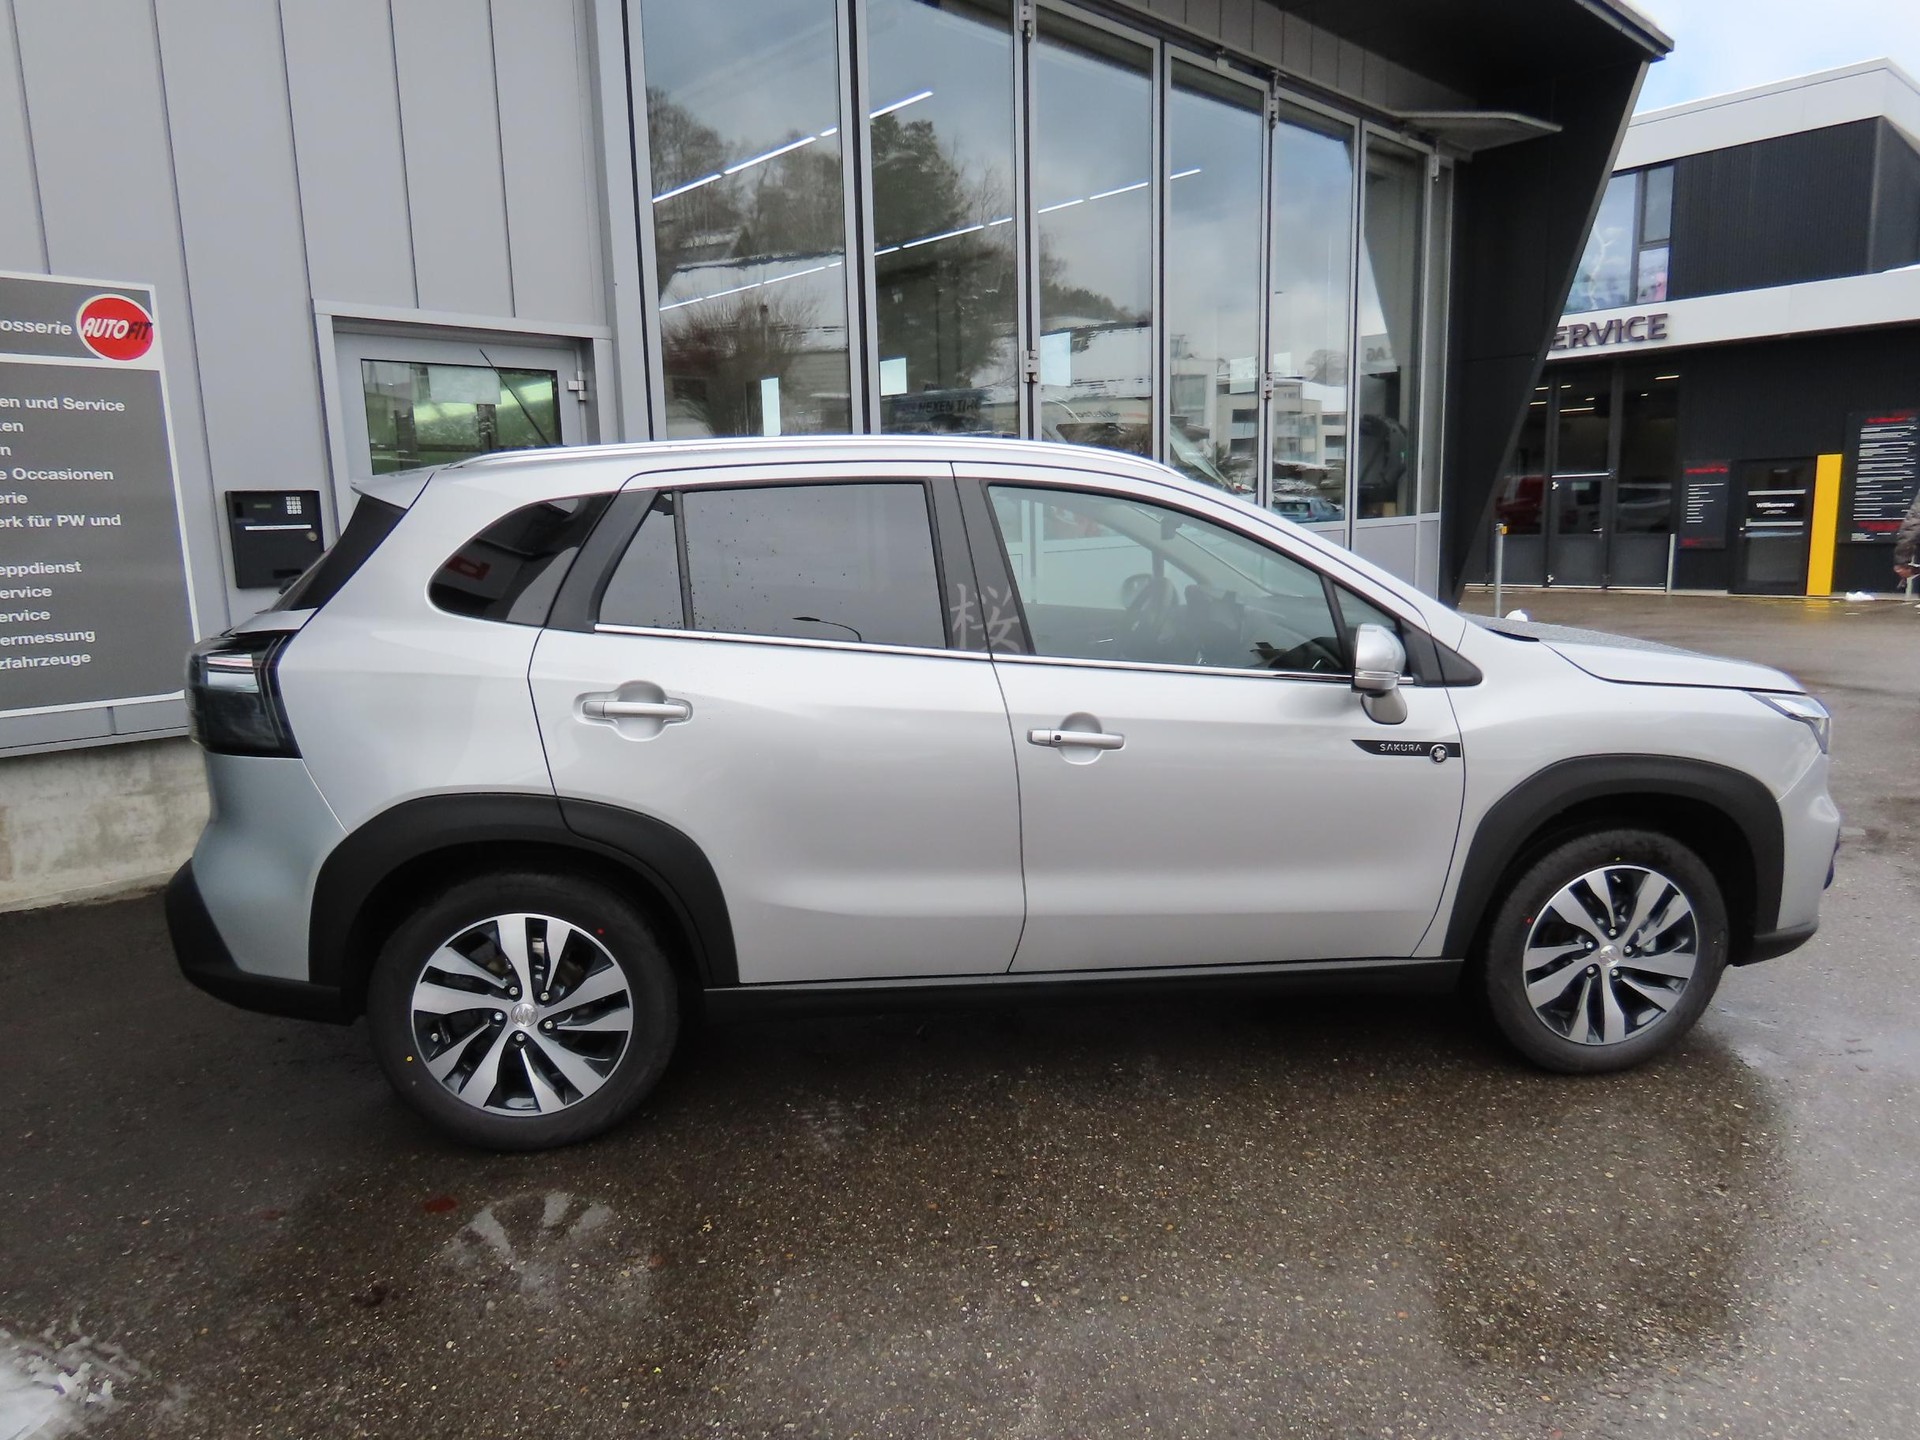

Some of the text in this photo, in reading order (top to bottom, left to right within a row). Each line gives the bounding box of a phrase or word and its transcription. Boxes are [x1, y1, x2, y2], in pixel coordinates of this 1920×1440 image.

[0, 318, 72, 336] osserie
[82, 317, 153, 340] AUTOFIT
[25, 397, 59, 410] und
[63, 397, 125, 412] Service
[13, 467, 114, 481] Occasionen
[28, 515, 53, 528] für
[57, 514, 86, 527] PW
[90, 513, 122, 526] und
[0, 586, 53, 599] ervice
[0, 630, 96, 646] ermessung
[1379, 743, 1422, 752] SAKURA
